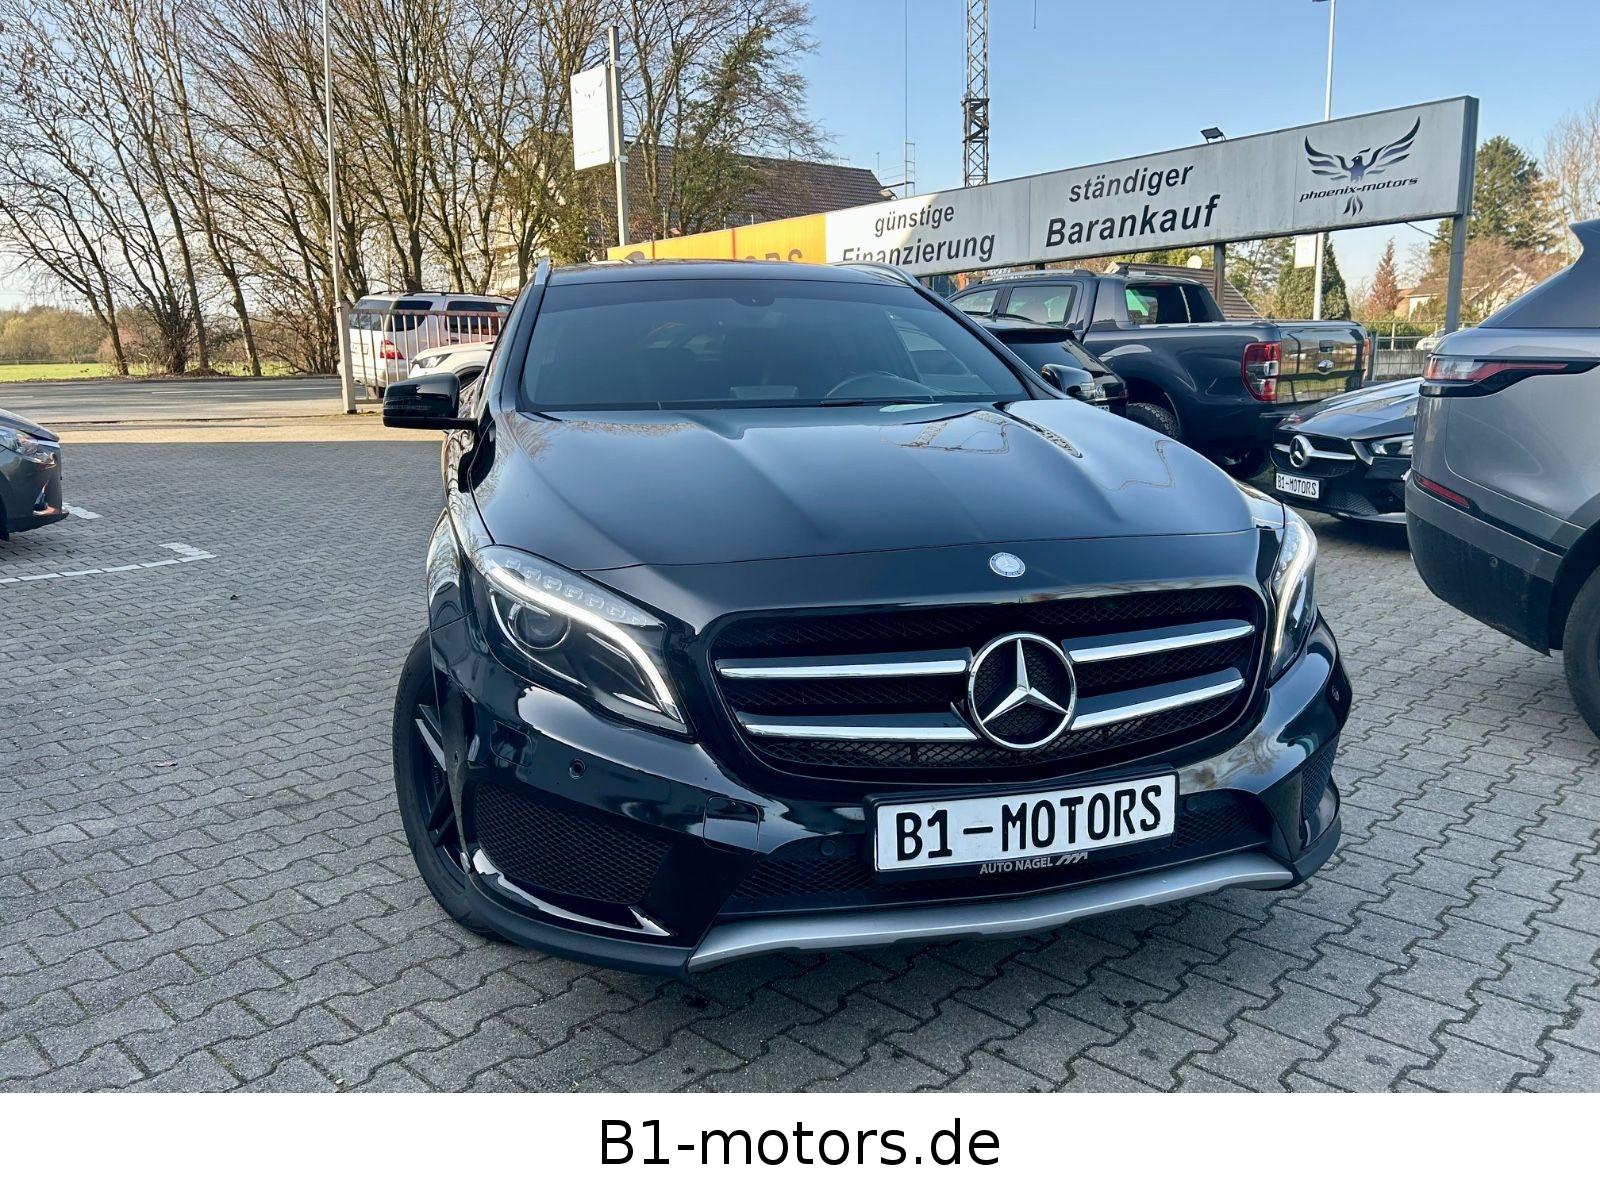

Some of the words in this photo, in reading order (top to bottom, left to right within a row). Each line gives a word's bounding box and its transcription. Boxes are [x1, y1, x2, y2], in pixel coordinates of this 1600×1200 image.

[1069, 165, 1194, 202] ständiger
[1299, 177, 1419, 202] phoenix-motors
[875, 204, 955, 237] günstige
[1046, 194, 1221, 247] Barankauf
[1278, 475, 1316, 495] B1-MOTORS
[980, 862, 1013, 874] AUTO
[1015, 857, 1053, 871] NAGEL
